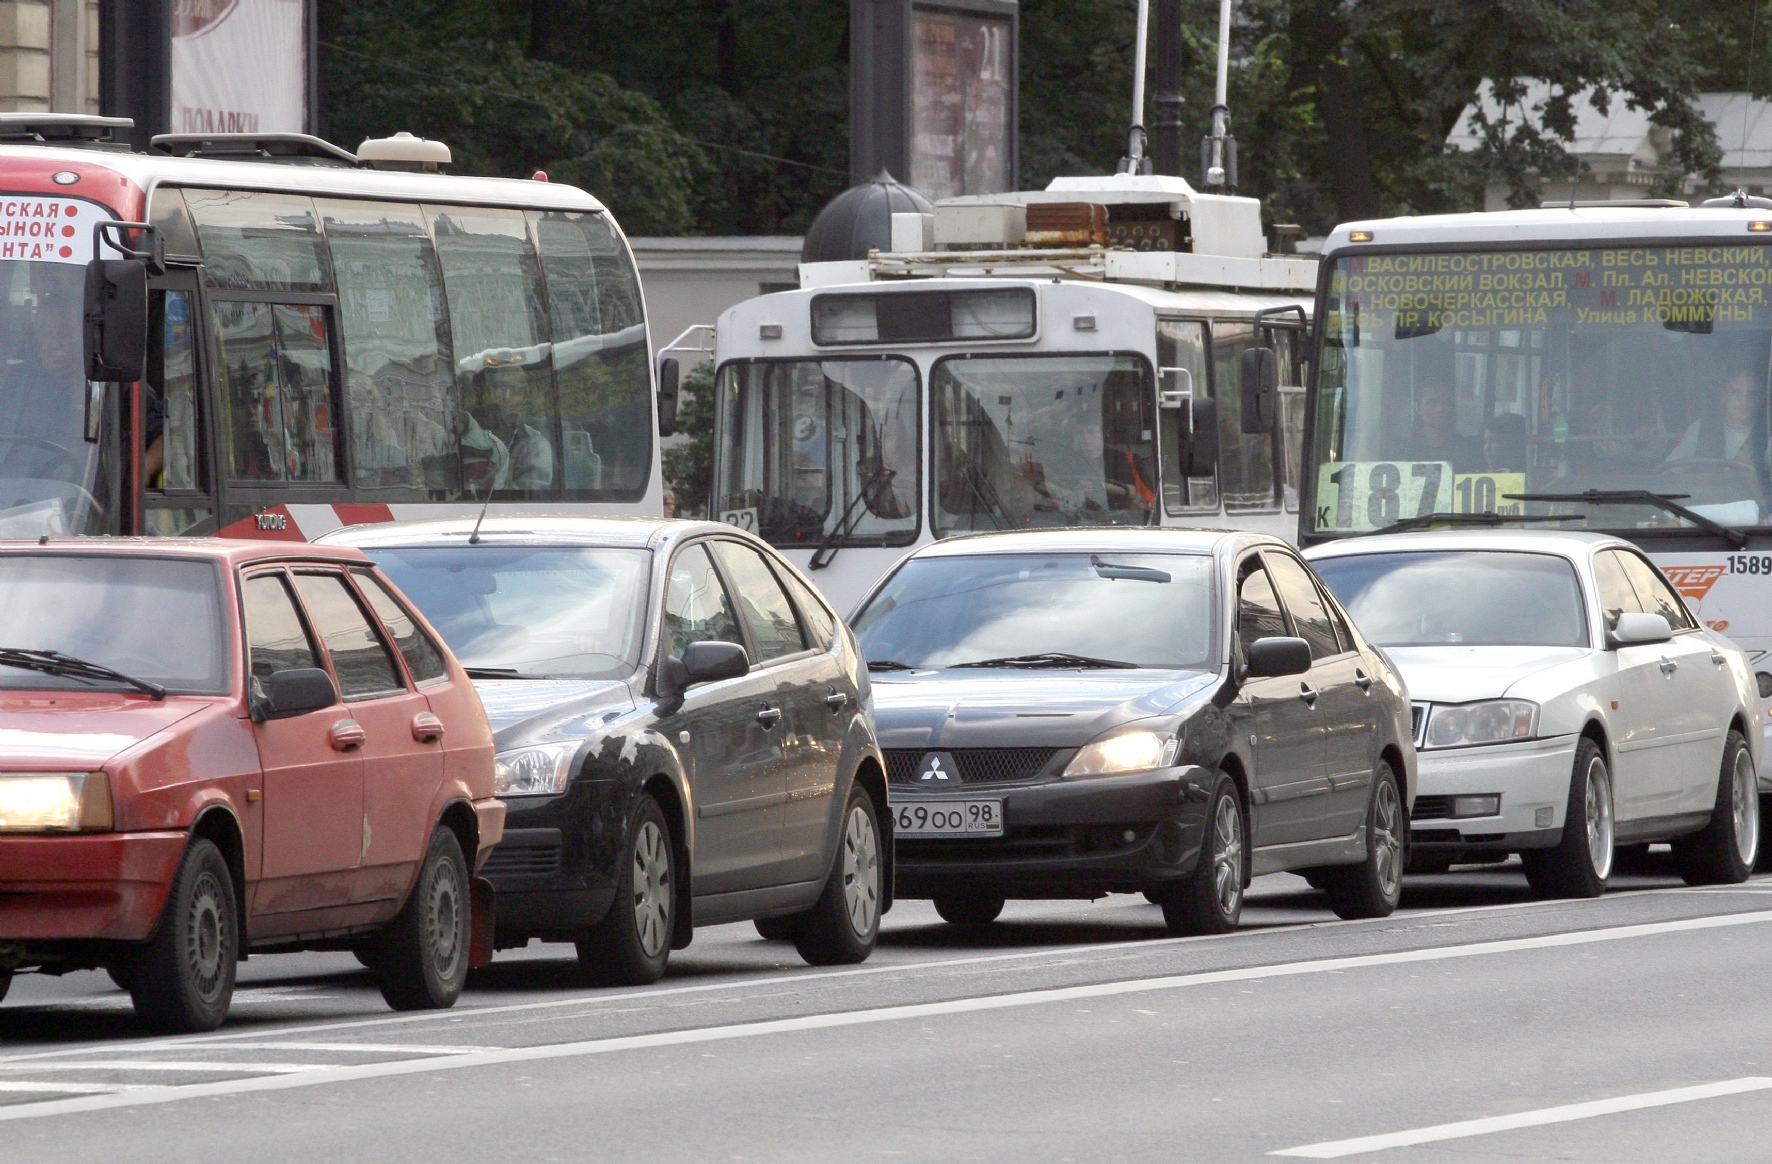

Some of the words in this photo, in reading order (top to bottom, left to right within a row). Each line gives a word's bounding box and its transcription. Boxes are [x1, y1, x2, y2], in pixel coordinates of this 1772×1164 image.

[0, 202, 59, 218] СКАЯ
[1602, 250, 1659, 266] ВЕСЬ
[1665, 247, 1770, 266] НЕВСКИЙ,
[1332, 271, 1473, 292] МОСКОВСКИЙ
[1479, 272, 1568, 291] ВОКЗАЛ,
[1603, 270, 1635, 287] Пл.
[1641, 270, 1674, 287] Ал.
[1370, 291, 1571, 310] НОВОЧЕРКАССКАЯ,
[1627, 287, 1768, 308] ЛАДОЖСКАЯ,
[1330, 312, 1384, 331] ВЕСЬ
[1428, 307, 1548, 327] КОСЫГИНА
[1576, 307, 1636, 326] Улица
[1643, 305, 1753, 323] КОММУНЫ
[1330, 463, 1443, 528] 187
[1456, 476, 1496, 514] 10
[1727, 555, 1772, 576] 1589
[968, 804, 993, 822] 98
[967, 822, 986, 830] RUS
